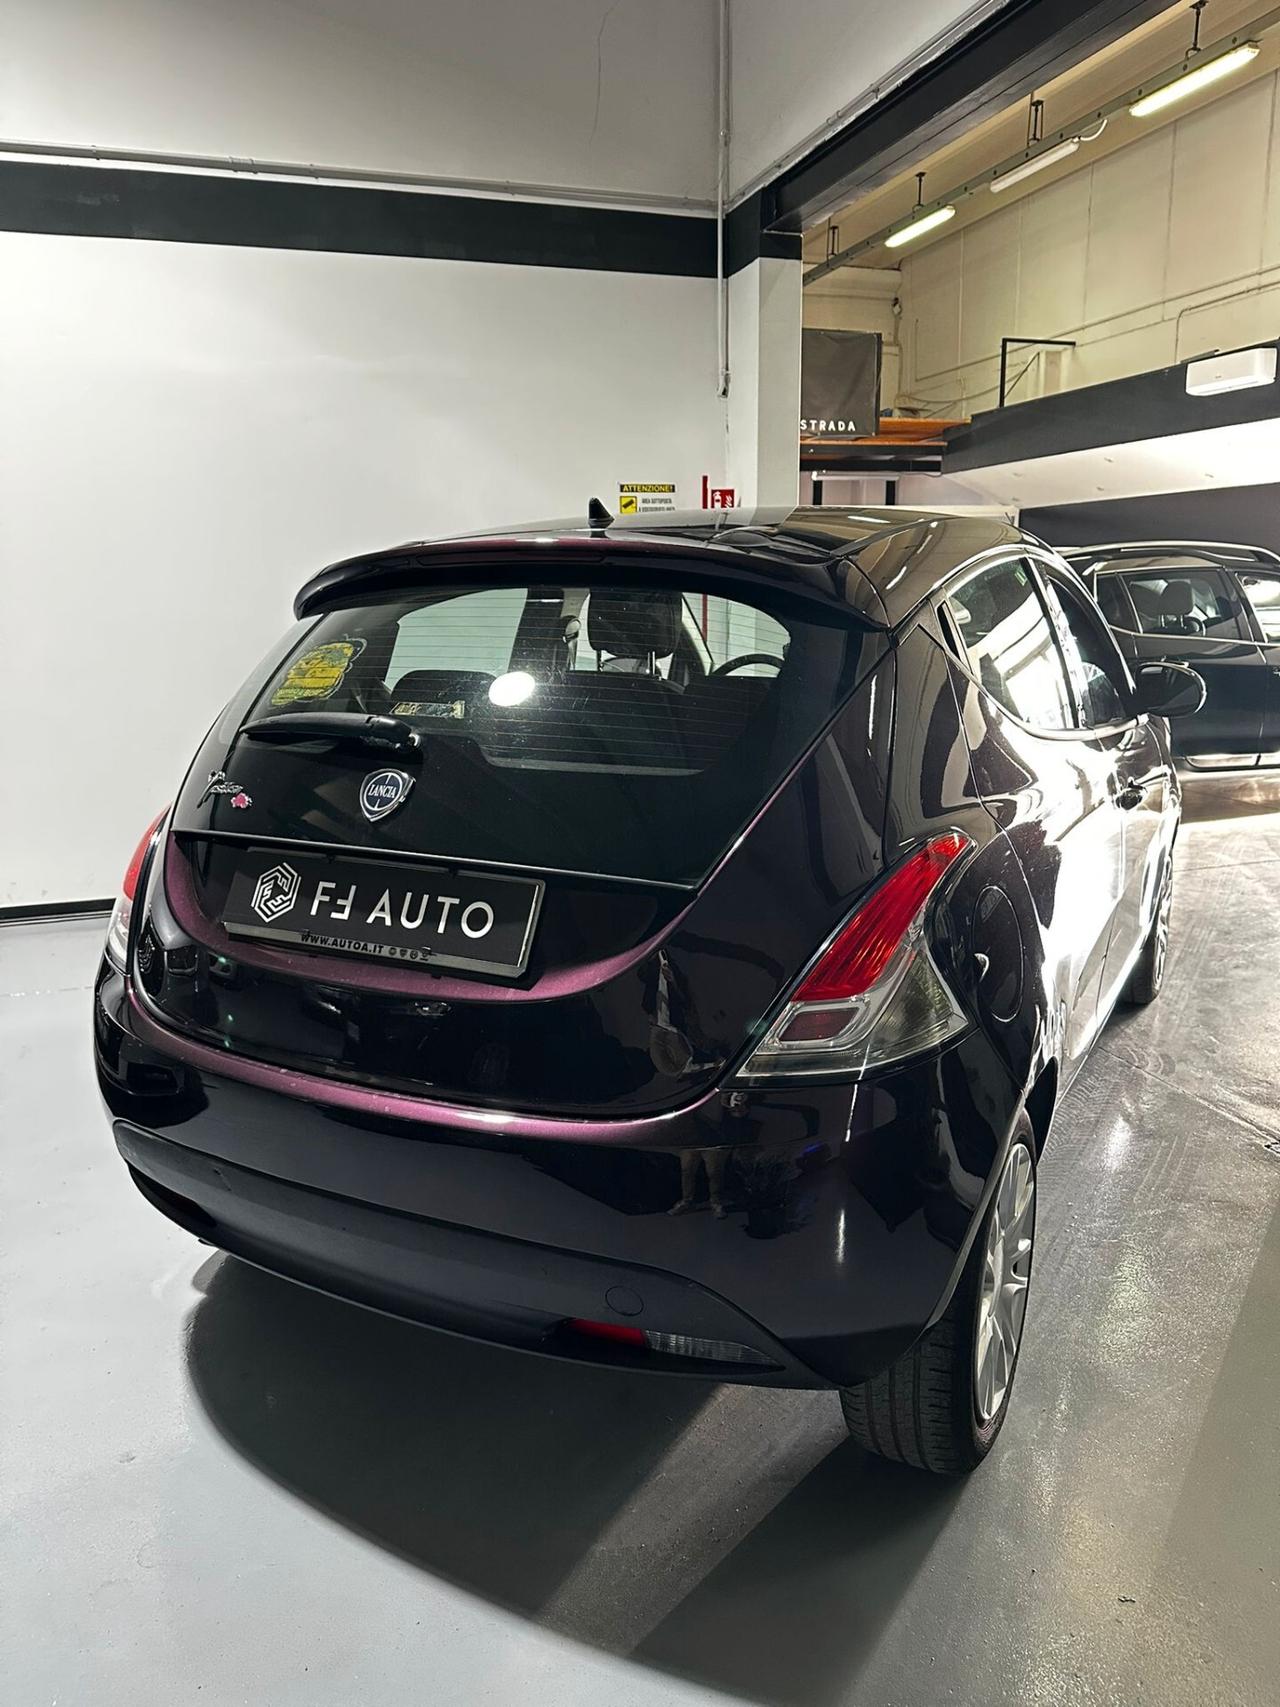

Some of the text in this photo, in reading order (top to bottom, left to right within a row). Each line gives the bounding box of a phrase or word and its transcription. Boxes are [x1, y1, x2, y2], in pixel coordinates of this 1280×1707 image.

[800, 419, 856, 431] STRADA
[368, 784, 397, 798] LANCIA
[366, 888, 494, 939] AUTO
[301, 933, 384, 954] WWW.AUTOA.IT
